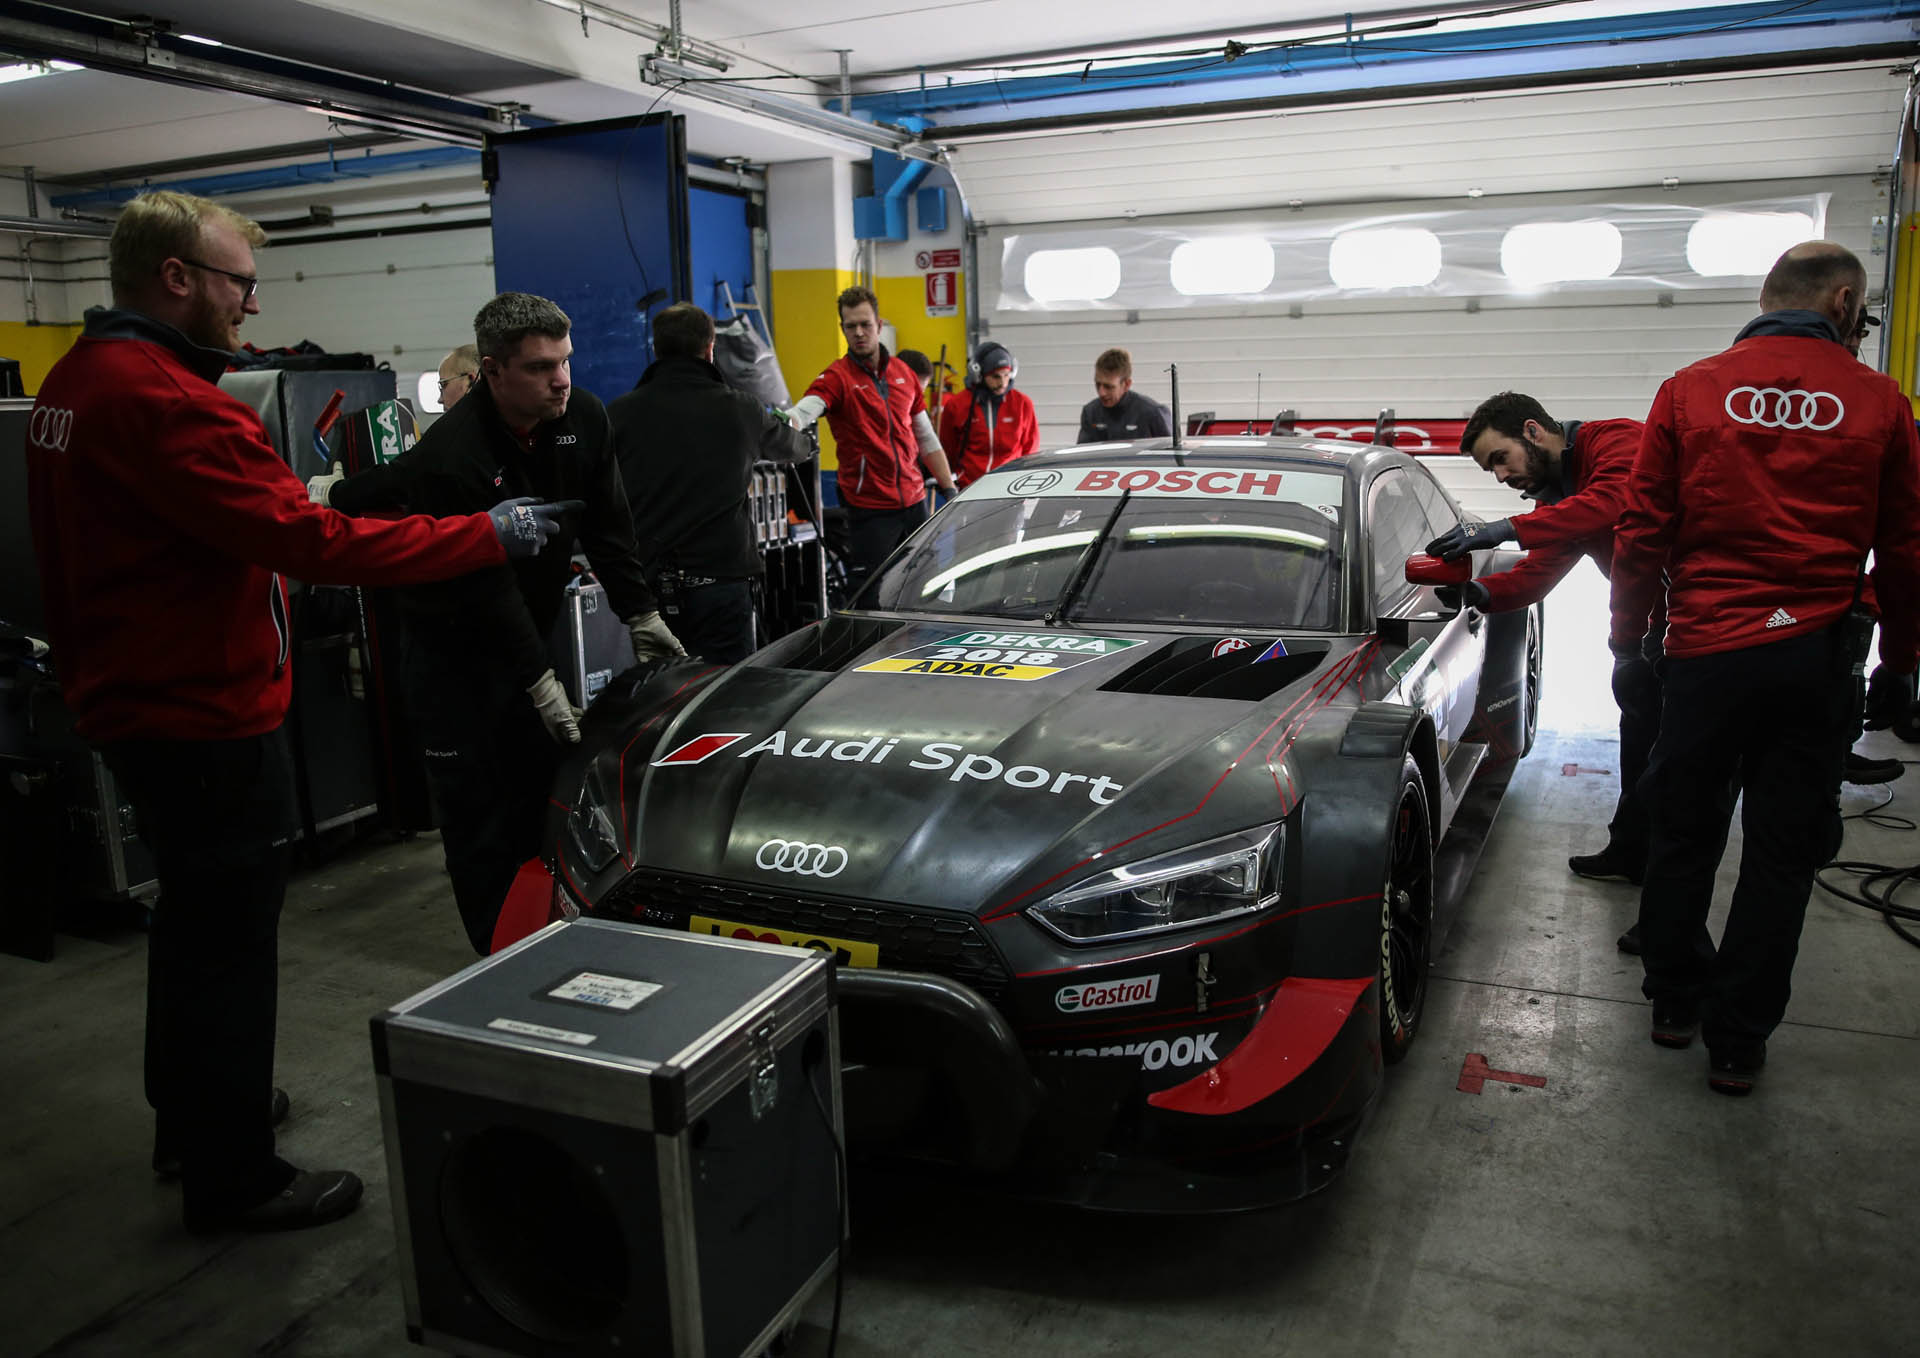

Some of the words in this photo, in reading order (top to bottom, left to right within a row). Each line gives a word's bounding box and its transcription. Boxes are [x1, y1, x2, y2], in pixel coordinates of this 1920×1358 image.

[1074, 469, 1284, 496] BOSCH
[1765, 617, 1797, 628] adidas
[959, 632, 1107, 653] DEKRA
[926, 646, 1060, 666] 2018
[902, 660, 1015, 678] ADAC
[737, 730, 901, 764] Audi
[908, 742, 1124, 806] Sport
[1081, 979, 1153, 1008] Castrol
